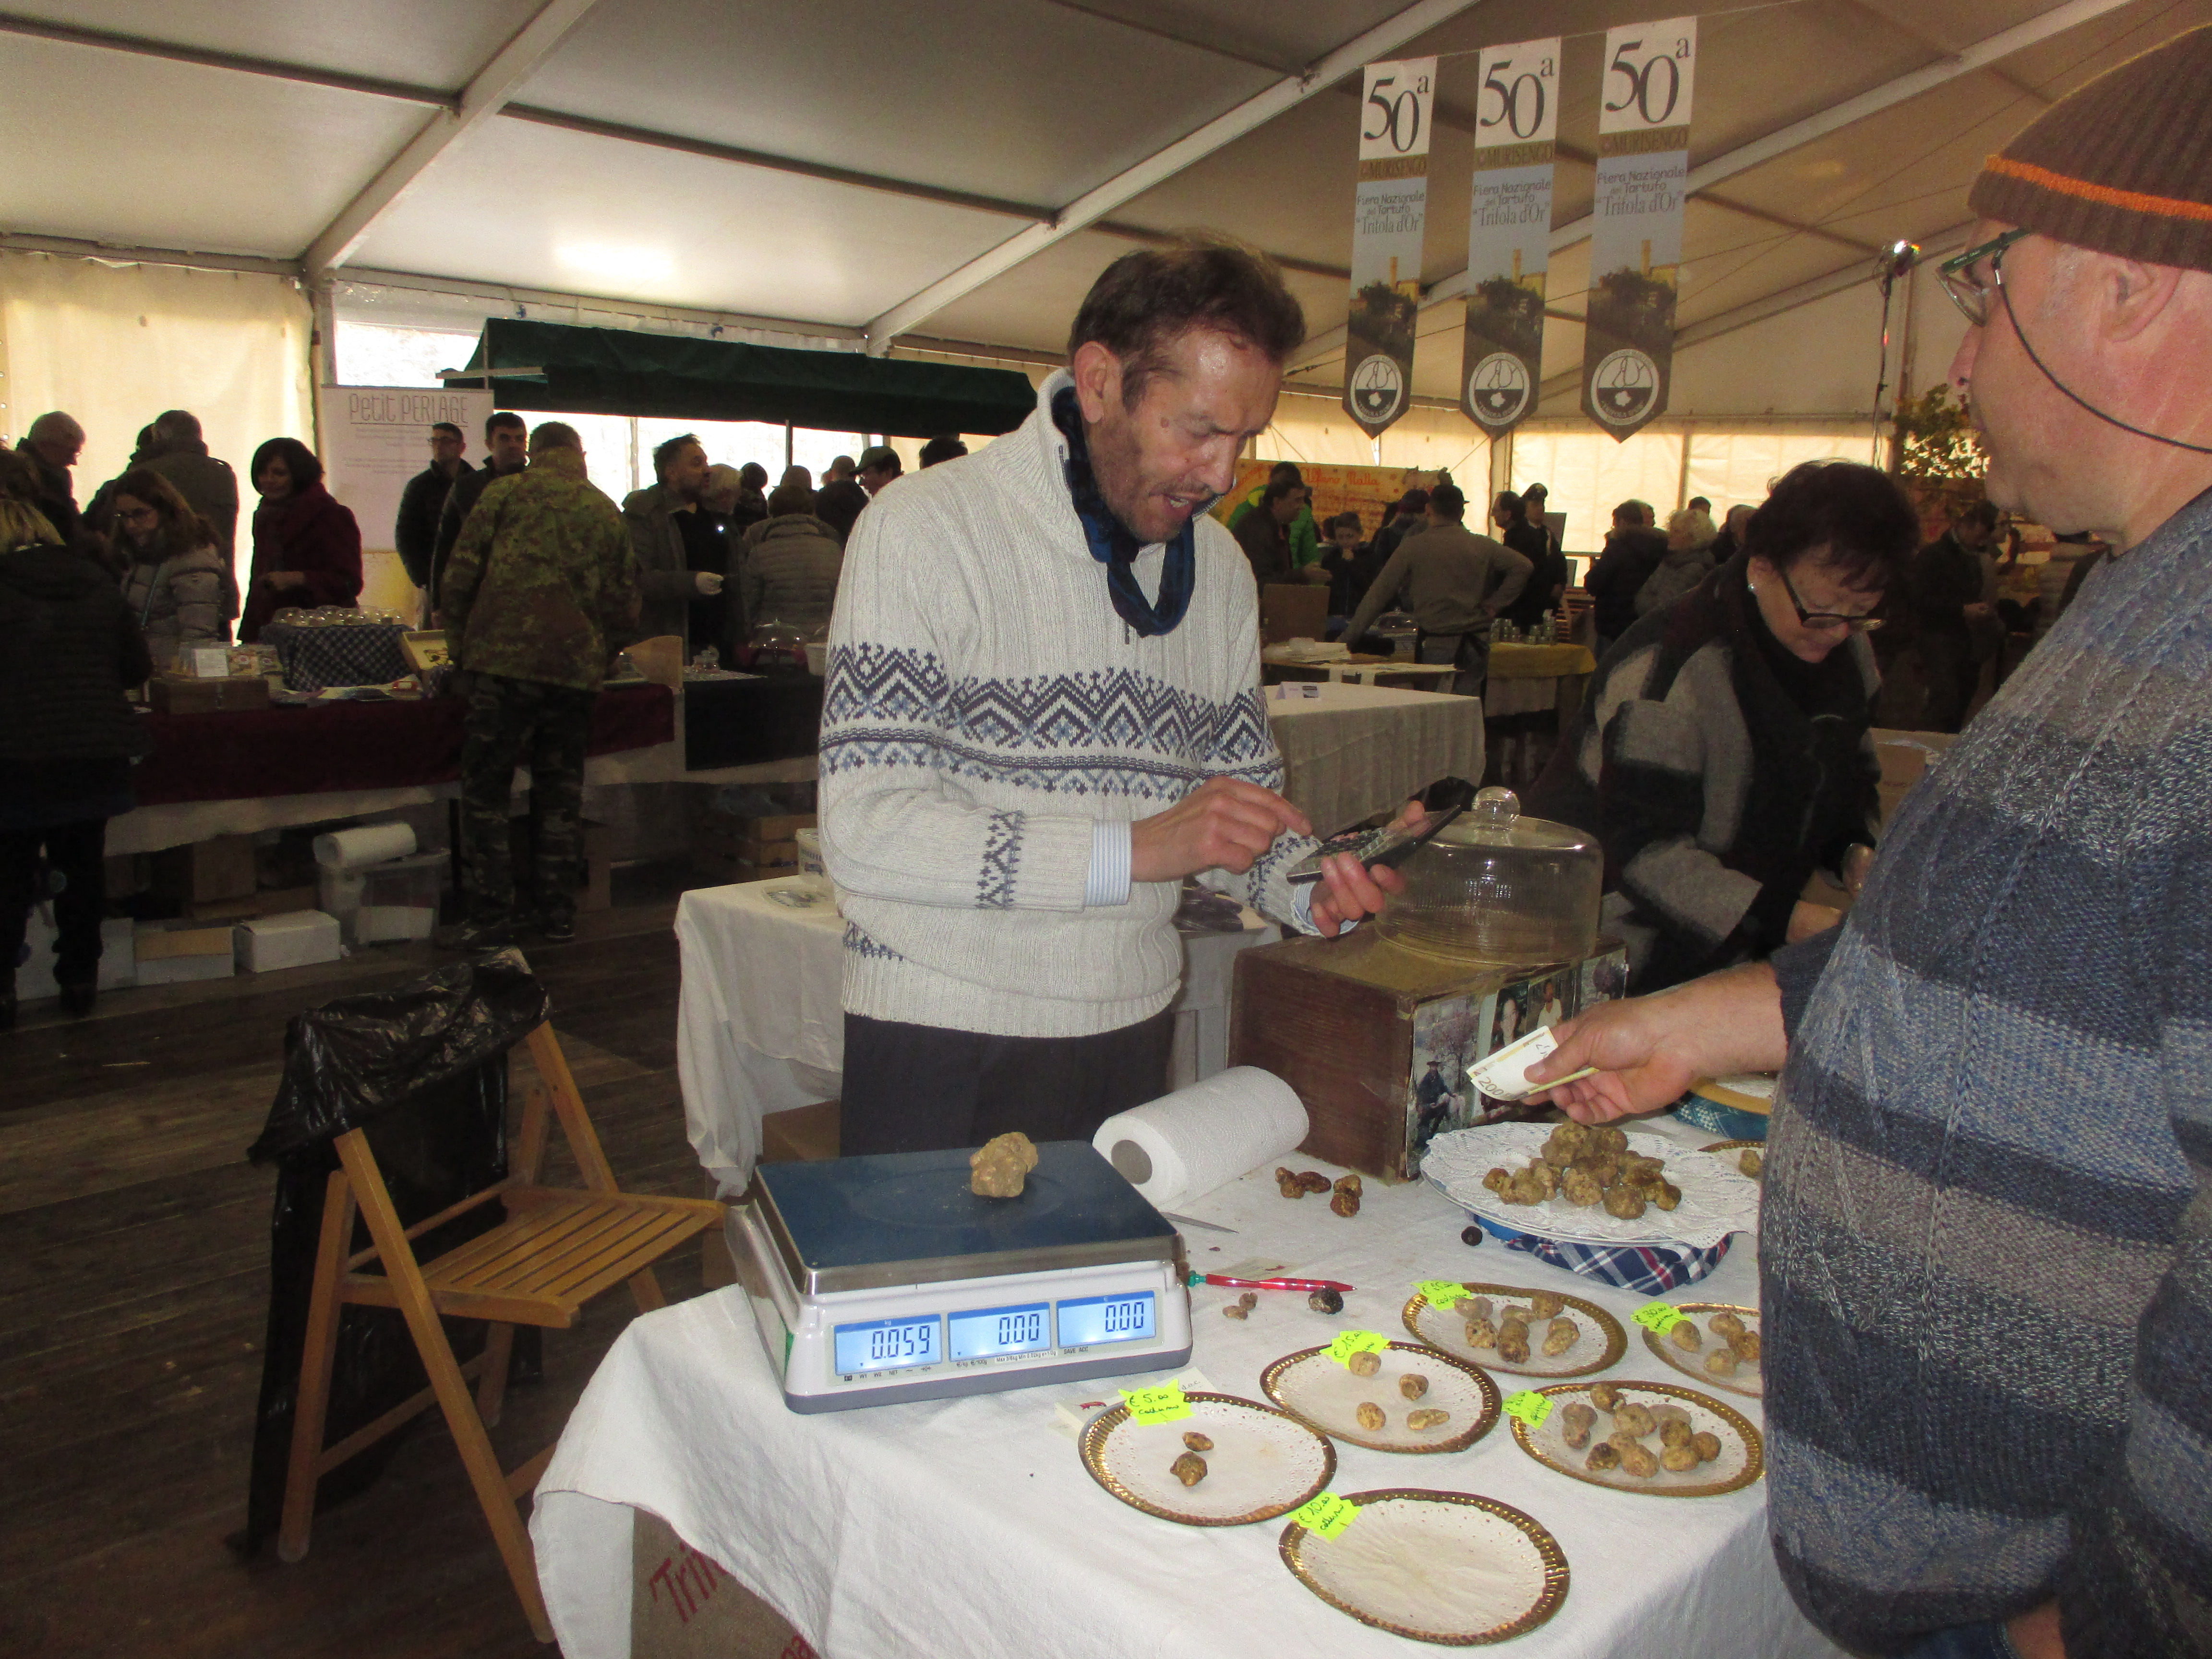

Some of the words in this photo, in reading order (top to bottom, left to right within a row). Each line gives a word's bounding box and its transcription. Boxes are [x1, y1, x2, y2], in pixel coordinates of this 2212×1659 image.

[1597, 172, 1625, 184] Fiera
[1628, 165, 1684, 181] Nazionale
[1474, 185, 1499, 196] Fiera
[1502, 178, 1551, 193] Nazionale
[1624, 180, 1667, 193] Tartufo
[1357, 195, 1379, 205] Fiera
[1381, 190, 1425, 204] Nazionale
[1497, 192, 1535, 205] Tartufo
[1378, 204, 1410, 215] Tartufo
[349, 393, 396, 421] Petit
[401, 395, 469, 423] PERLAGE
[1478, 1076, 1504, 1096] 200
[1106, 1301, 1144, 1333] 0.00
[998, 1313, 1040, 1345] 0.00
[871, 1325, 930, 1359] 0.059
[1129, 1395, 1140, 1407] €
[1142, 1393, 1169, 1403] 5.00
[1306, 1496, 1330, 1516] 10.00
